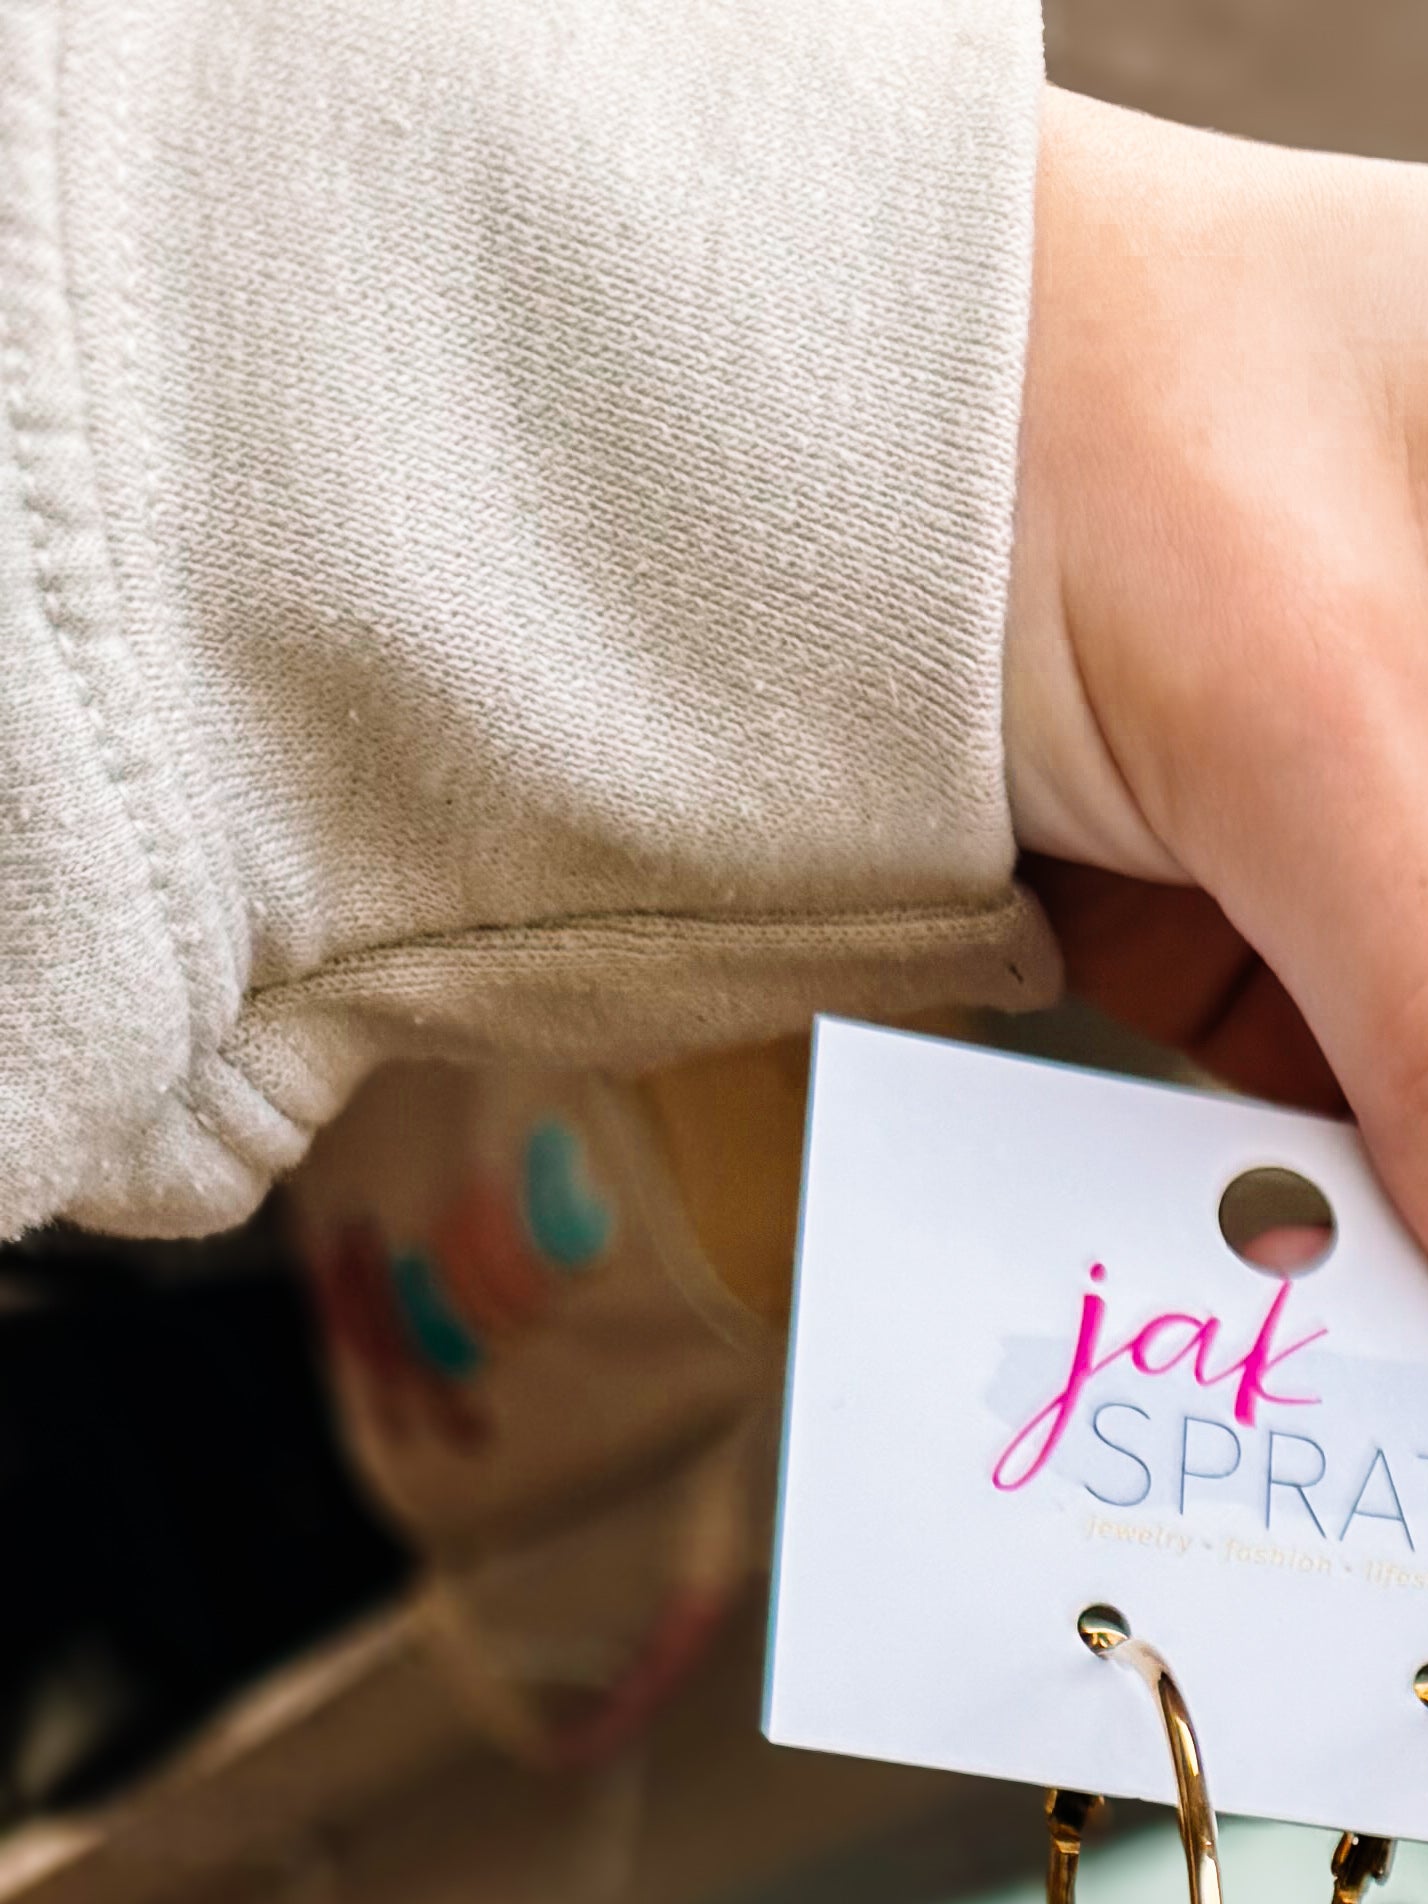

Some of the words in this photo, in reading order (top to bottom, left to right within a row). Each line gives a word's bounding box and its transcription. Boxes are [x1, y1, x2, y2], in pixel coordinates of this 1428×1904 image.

[992, 1262, 1328, 1492] jak
[1086, 1517, 1192, 1554] jewelry
[1223, 1537, 1333, 1576] fashion
